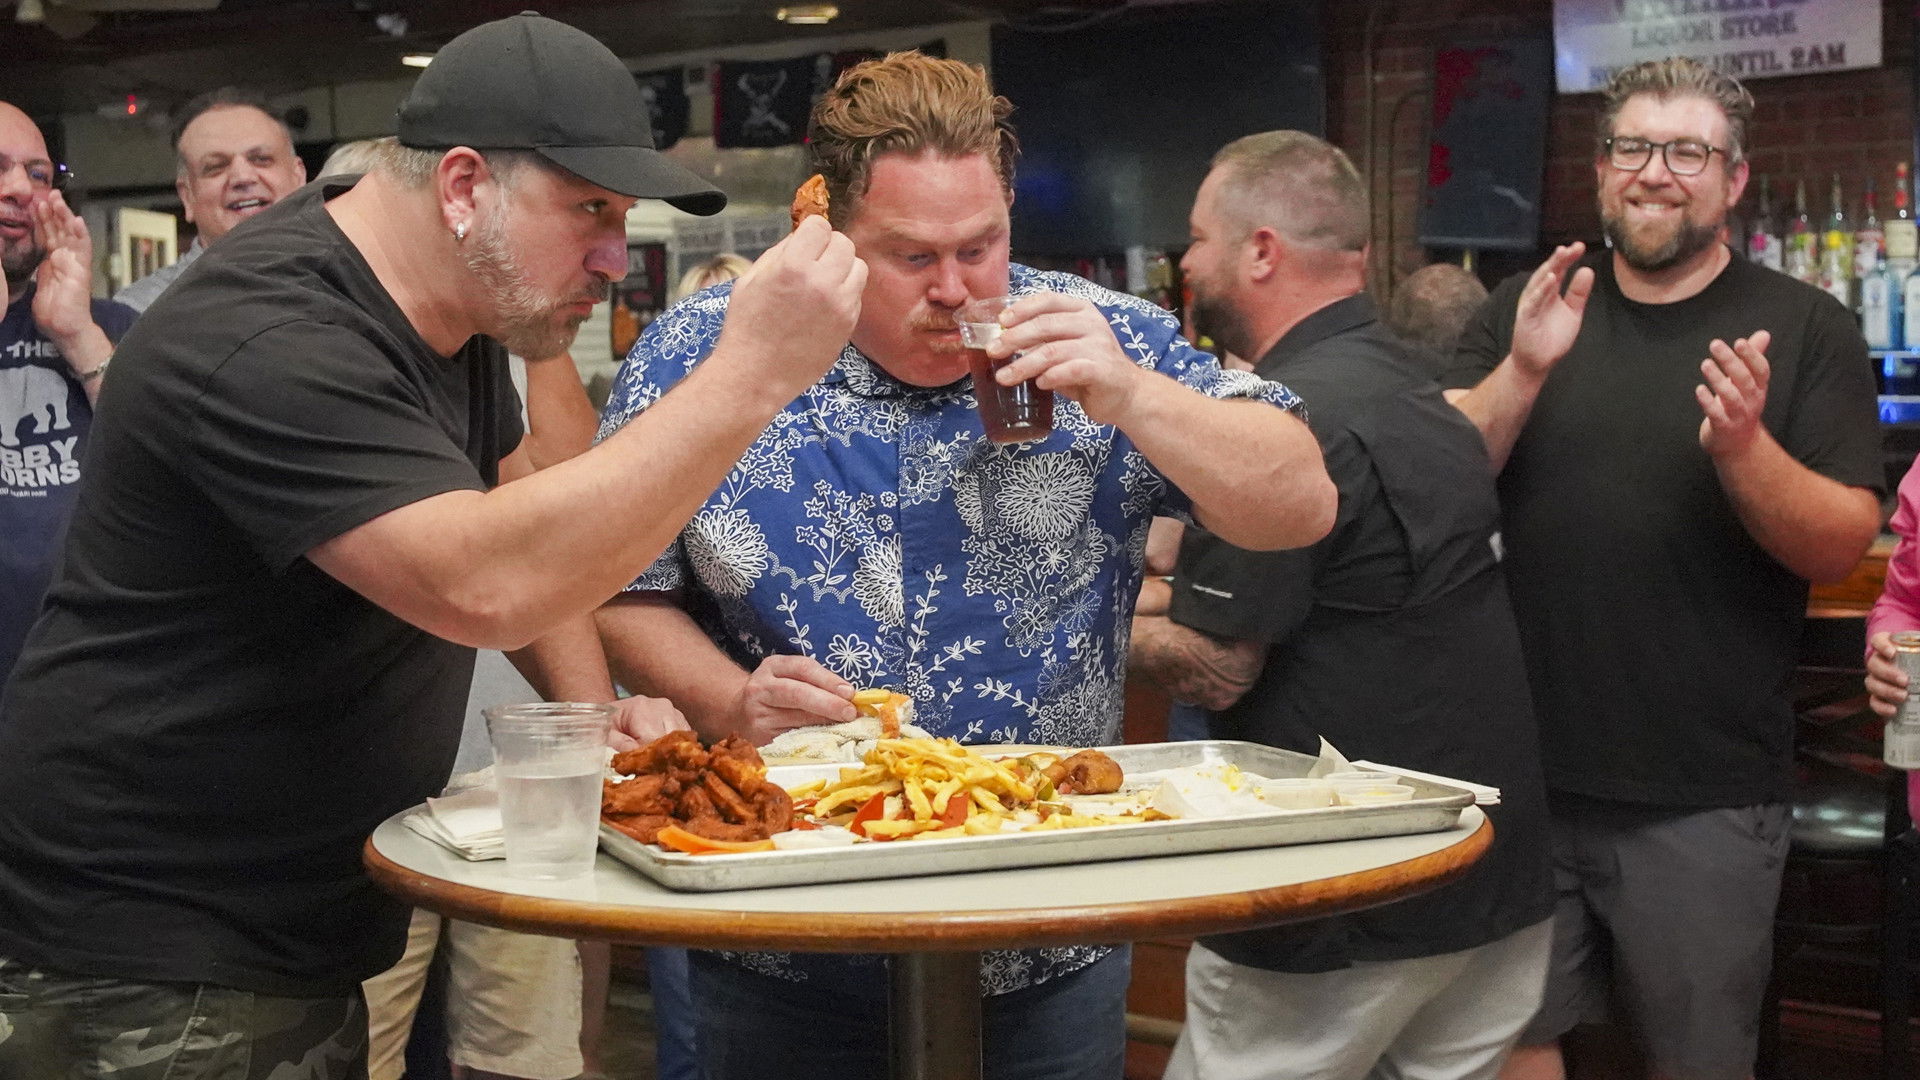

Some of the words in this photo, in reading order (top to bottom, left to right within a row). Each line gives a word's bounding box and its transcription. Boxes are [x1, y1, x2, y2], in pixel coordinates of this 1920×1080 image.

[1720, 12, 1798, 40] STORE
[1790, 42, 1846, 68] 2AM
[6, 339, 60, 359] THE
